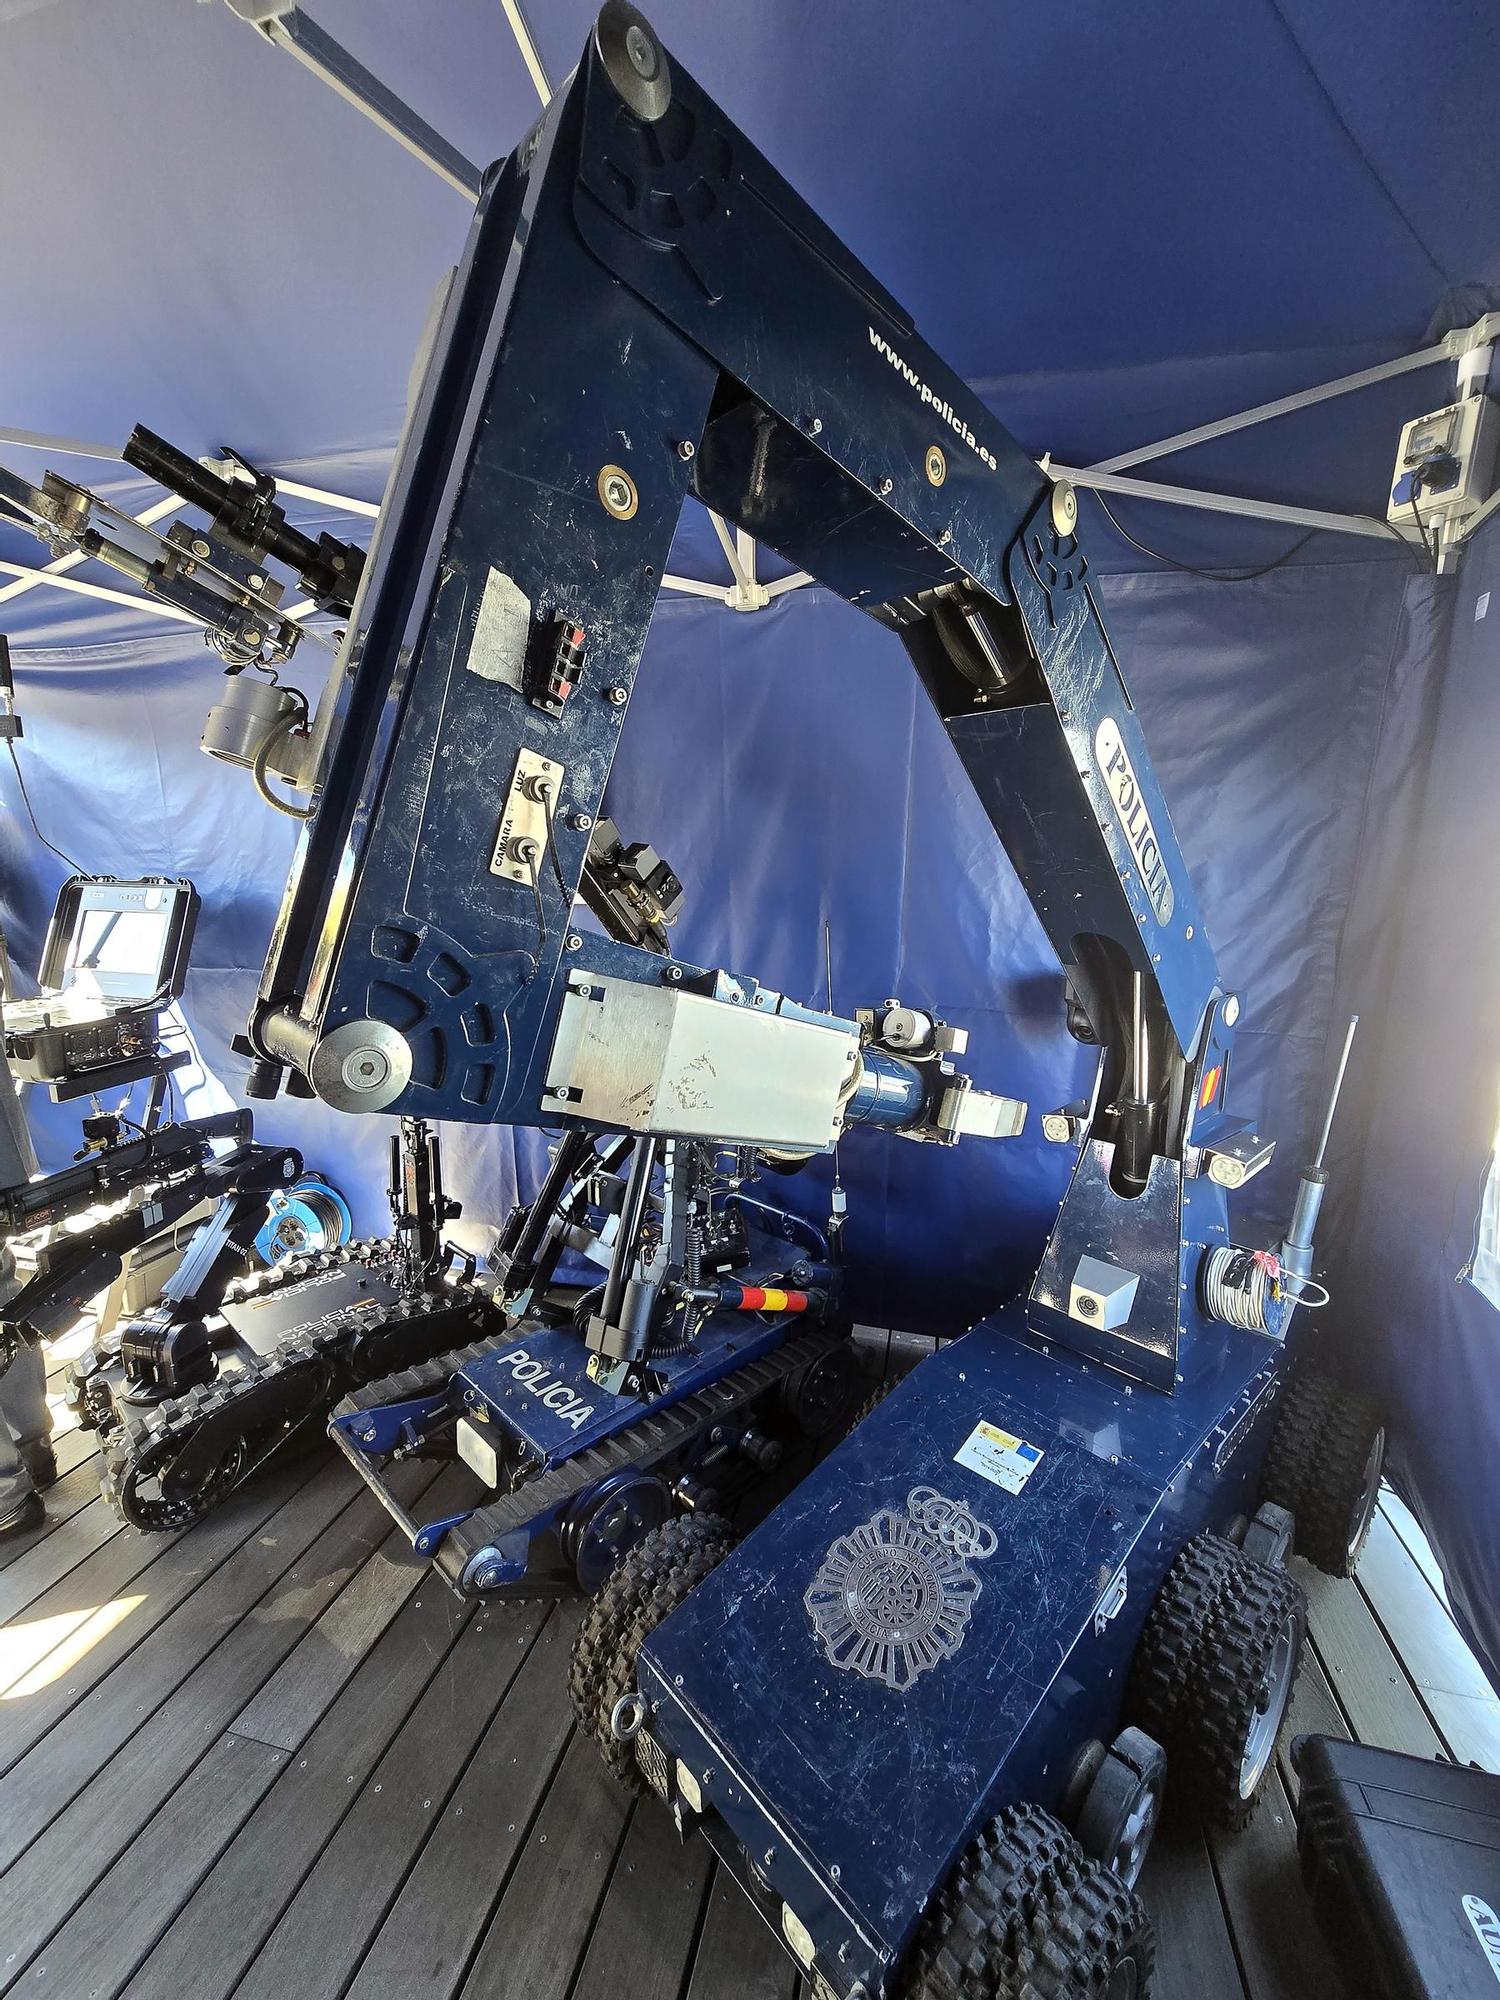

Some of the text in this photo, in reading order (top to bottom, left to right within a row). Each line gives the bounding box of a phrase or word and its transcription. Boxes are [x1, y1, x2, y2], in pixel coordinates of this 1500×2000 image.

[868, 326, 998, 472] www.policia.es
[514, 769, 526, 792] LUZ
[494, 819, 514, 867] CAMARA
[1105, 742, 1169, 913] POLICIA
[225, 1239, 241, 1254] TITAN
[277, 1305, 356, 1338] POLICIA
[496, 1349, 595, 1431] POLICIA
[857, 1548, 897, 1570] CUERPO
[905, 1552, 938, 1602] NACIONAL
[853, 1604, 888, 1638] POLICIA
